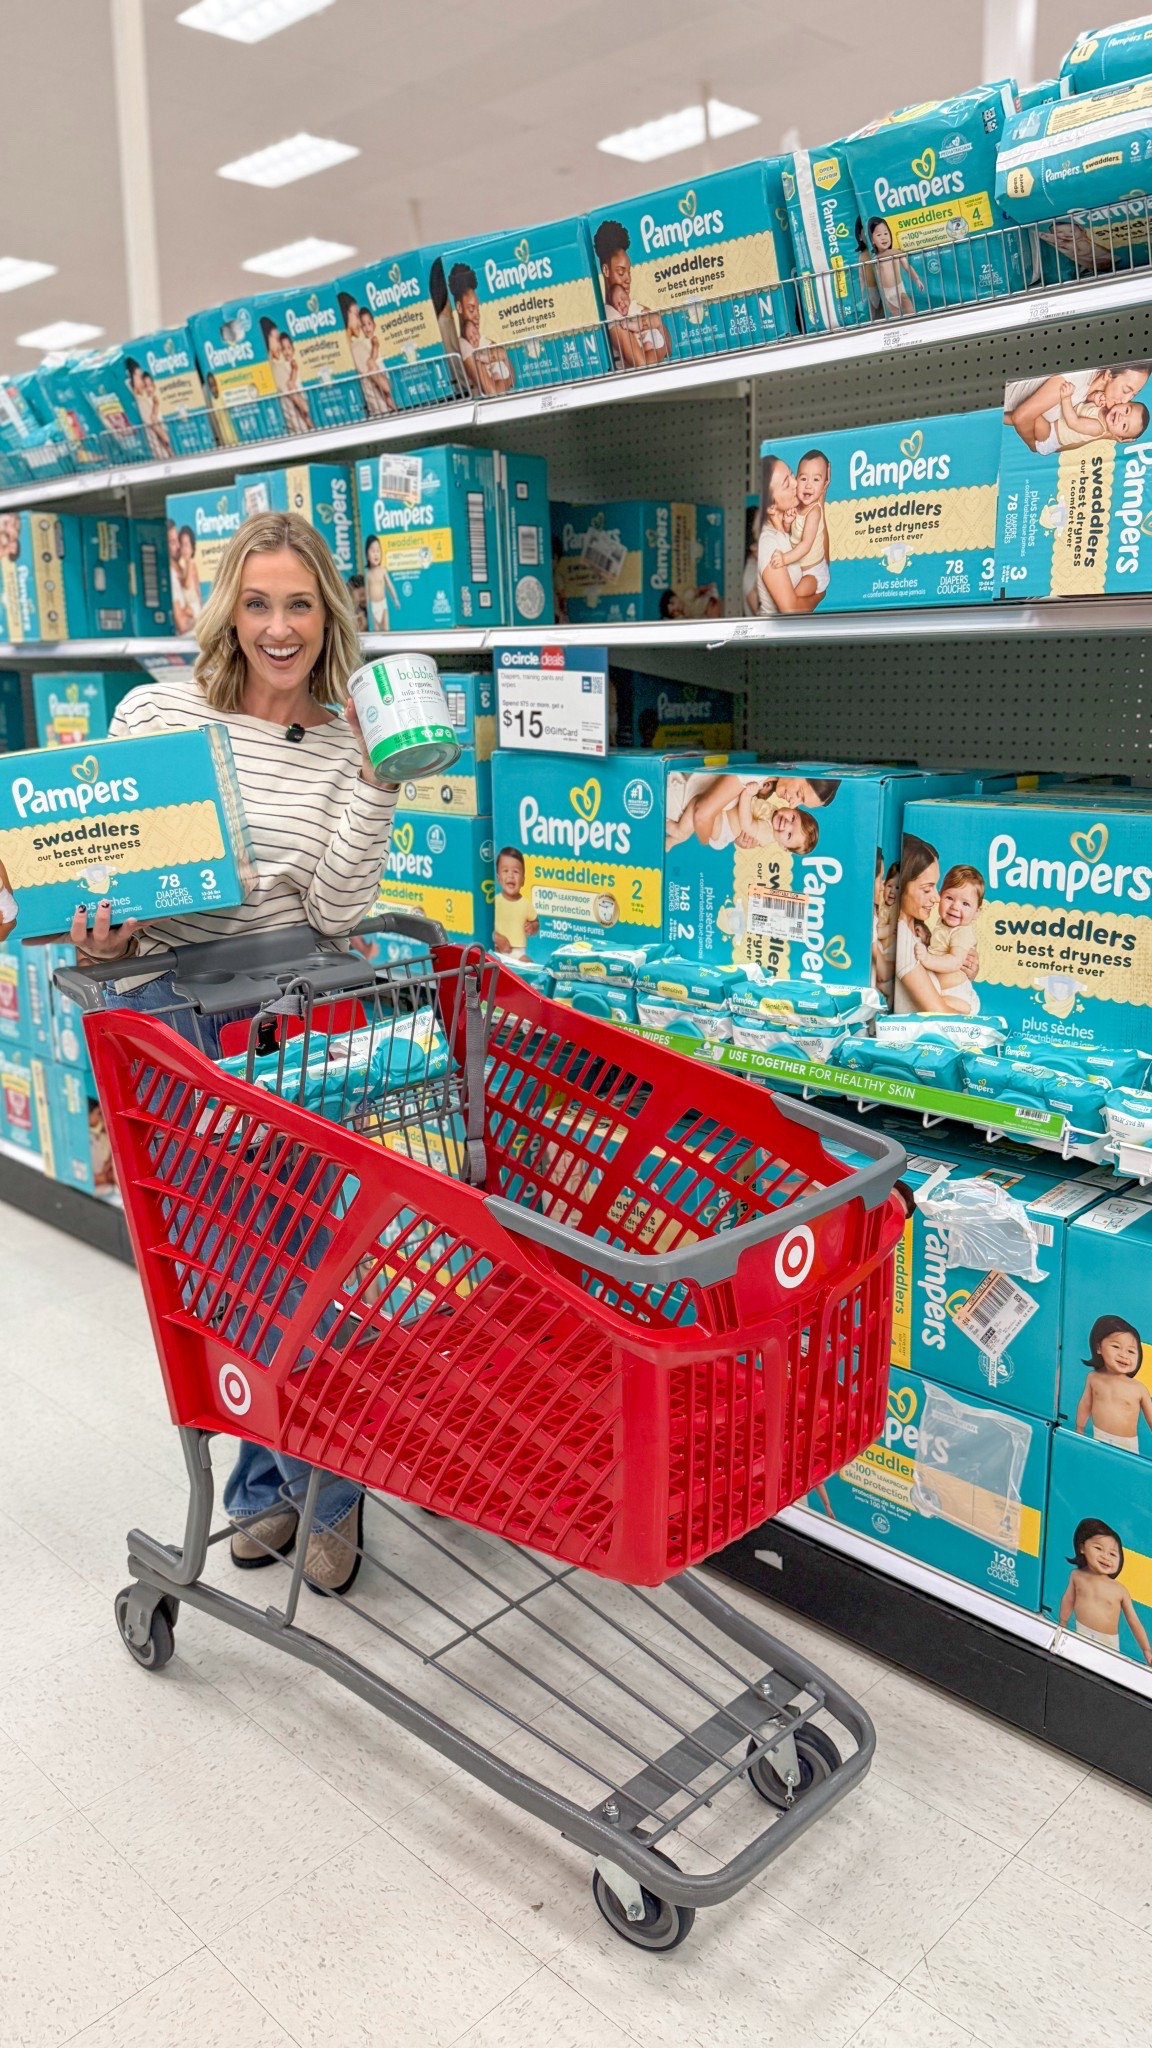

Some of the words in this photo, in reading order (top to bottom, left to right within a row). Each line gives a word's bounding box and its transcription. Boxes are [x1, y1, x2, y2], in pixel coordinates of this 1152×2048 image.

[940, 144, 972, 158] PEDIATRICIAN
[1130, 142, 1140, 155] 3
[819, 165, 834, 174] OPEN
[1046, 166, 1081, 183] Pampers
[1085, 155, 1120, 170] swaddlers
[874, 170, 965, 213] Pampers
[898, 207, 954, 229] swaddlers
[972, 207, 981, 220] 4
[640, 210, 724, 254] Pampers
[822, 199, 839, 256] Pampers
[902, 240, 916, 250] skin
[916, 233, 948, 247] protection
[484, 256, 552, 294] Pampers
[654, 254, 724, 282] swaddlers
[667, 277, 688, 291] best
[689, 270, 726, 288] dryness
[674, 288, 700, 298] comfort
[700, 284, 714, 292] ever
[366, 277, 420, 312] Pampers
[498, 297, 554, 320] swaddlers
[734, 304, 748, 318] 34
[758, 296, 773, 318] N
[286, 308, 336, 338] Pampers
[380, 312, 424, 332] swaddlers
[509, 316, 526, 328] best
[526, 310, 556, 326] dryness
[204, 340, 254, 370] Pampers
[299, 338, 339, 357] swaddlers
[147, 350, 188, 376] Pampers
[850, 450, 951, 491] Pampers
[1007, 494, 1018, 511] 78
[1030, 490, 1038, 510] plus
[1077, 476, 1089, 510] best
[374, 500, 434, 532] Pampers
[854, 500, 942, 524] swaddlers
[1084, 456, 1104, 568] swaddlers
[1115, 442, 1152, 574] Pampers
[195, 507, 240, 536] Pampers
[331, 478, 352, 571] Pampers
[868, 524, 892, 534] best
[894, 519, 940, 538] dryness
[387, 536, 424, 549] swaddlers
[874, 533, 905, 543] comfort
[906, 532, 924, 541] ever
[1066, 526, 1074, 548] ever
[1074, 511, 1087, 567] dryness
[650, 508, 670, 590] Pampers
[944, 560, 964, 574] 78
[980, 558, 995, 580] 3
[1010, 566, 1028, 580] 3
[872, 580, 890, 592] plus
[936, 584, 970, 595] COUCHES
[940, 576, 968, 586] DIAPERS
[626, 602, 636, 617] 4
[512, 652, 539, 666] circle
[541, 652, 565, 666] deals
[397, 666, 434, 680] bobbie
[501, 672, 522, 680] Diapers,
[522, 674, 540, 682] training
[657, 692, 712, 722] Pampers
[502, 709, 543, 738] $15
[550, 728, 578, 737] GiftCard
[12, 776, 140, 818] Pampers
[631, 784, 642, 800] #1
[32, 822, 140, 850] swaddlers
[519, 796, 632, 856] Pampers
[38, 854, 52, 862] our
[53, 846, 84, 860] best
[88, 838, 141, 856] dryness
[65, 854, 102, 868] comfort
[104, 852, 124, 862] ever
[534, 866, 616, 888] swaddlers
[988, 834, 1152, 902] Pampers
[158, 874, 180, 890] 78
[200, 869, 216, 890] 3
[632, 880, 643, 900] 2
[155, 896, 194, 909] COUCHES
[156, 887, 188, 900] DIAPERS
[538, 889, 558, 900] 100%
[558, 894, 590, 904] LEAKPROOF
[680, 886, 690, 911] 148
[704, 886, 715, 911] plus
[446, 898, 453, 913] 3
[535, 902, 550, 911] skin
[552, 903, 590, 917] protection
[539, 929, 572, 942] protection
[552, 920, 572, 931] 100%
[572, 924, 586, 933] SANS
[588, 926, 605, 936] FUITES
[677, 923, 694, 940] 2
[994, 917, 1136, 951] swaddlers
[995, 944, 1013, 952] our
[1016, 940, 1054, 958] best
[1060, 948, 1132, 968] dryness
[1026, 960, 1074, 974] comfort
[1077, 968, 1105, 978] ever
[662, 986, 683, 995] sensitive
[1022, 1016, 1048, 1032] plus
[1050, 1021, 1094, 1040] sèches
[1004, 1046, 1031, 1058] Pampers
[728, 1049, 749, 1063] USE
[750, 1054, 806, 1076] TOGETHER
[808, 1065, 832, 1080] FOR
[834, 1070, 886, 1092] HEALTHY
[888, 1082, 916, 1100] SKIN
[962, 1078, 994, 1094] Pampers
[917, 1220, 949, 1350] Pampers
[844, 1470, 862, 1482] skin
[863, 1476, 909, 1502] protection
[856, 1462, 876, 1477] 100%
[877, 1475, 908, 1492] LEAKPROOF
[990, 1560, 1016, 1578] DIAPERS
[993, 1550, 1016, 1569] 120
[986, 1567, 1020, 1588] COUCHES
